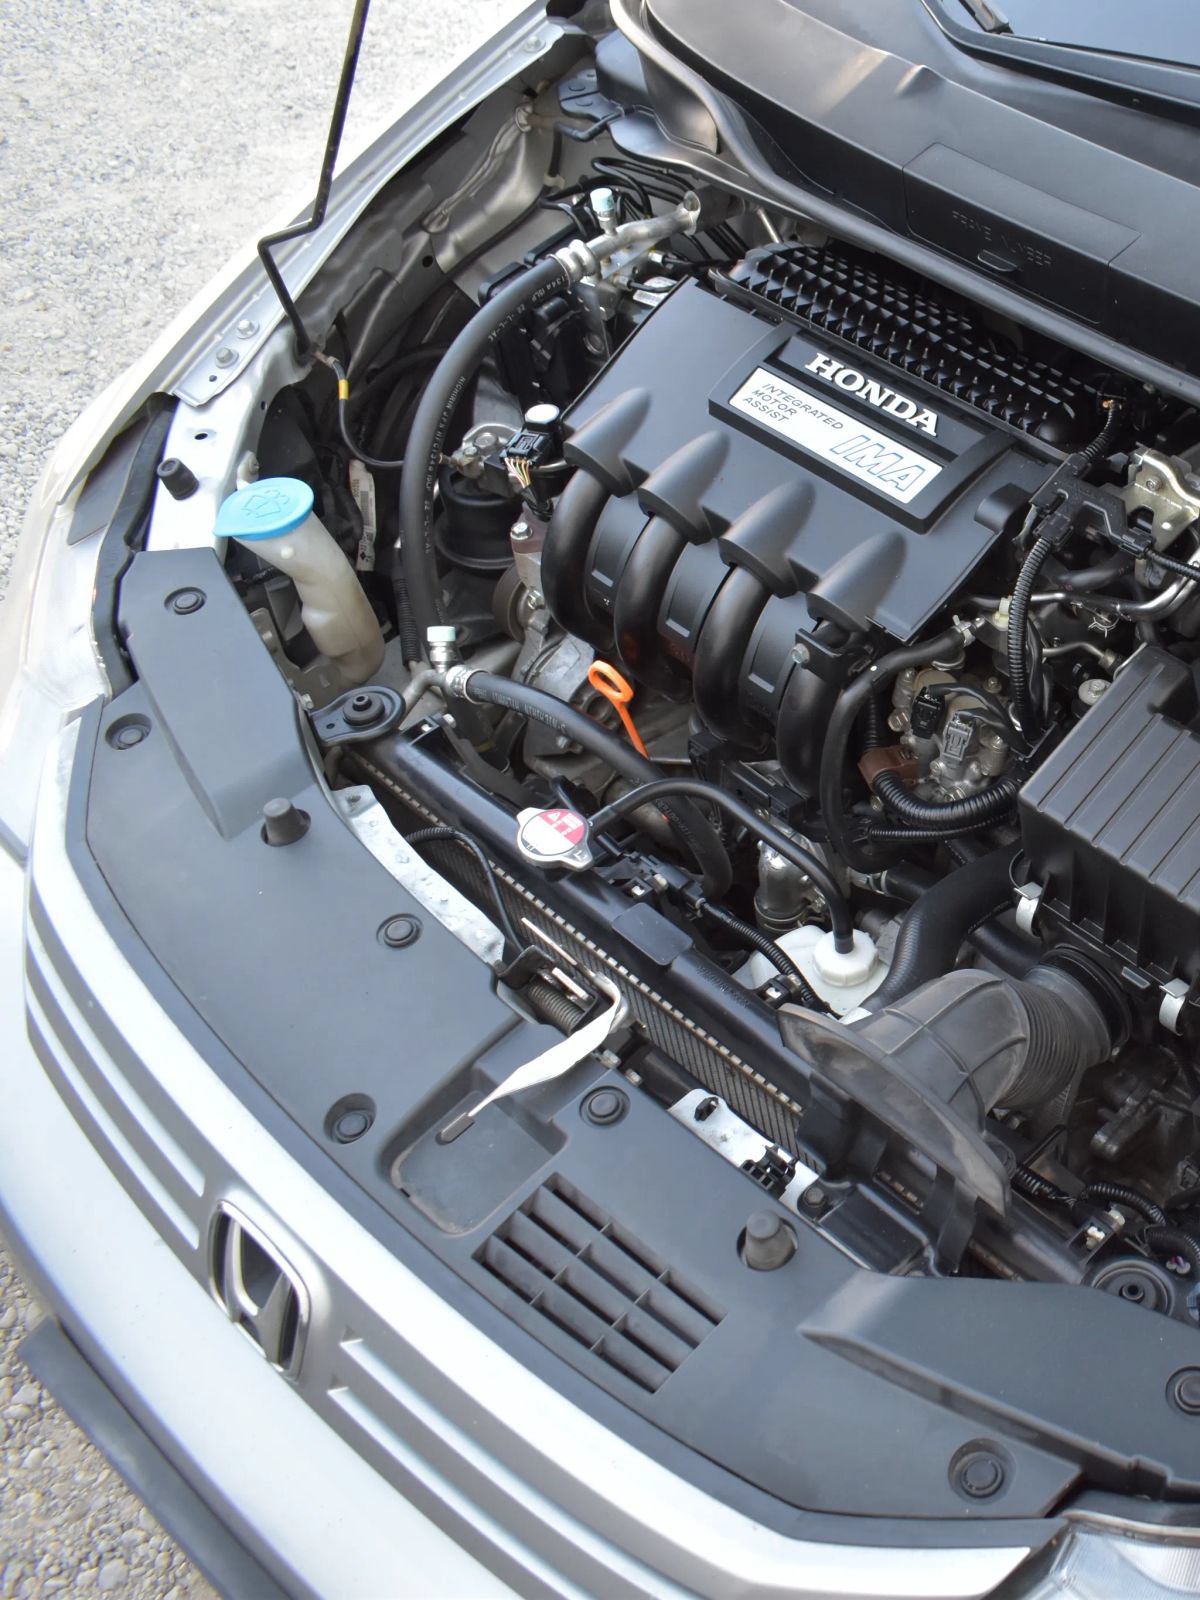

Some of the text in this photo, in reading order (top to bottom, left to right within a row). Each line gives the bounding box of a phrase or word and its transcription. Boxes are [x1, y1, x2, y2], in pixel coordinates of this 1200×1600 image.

[742, 397, 791, 423] ASSIST
[752, 389, 798, 416] MOTOR
[762, 383, 844, 431] INTEGRATED
[805, 352, 940, 437] HONDA
[829, 434, 926, 492] IMA
